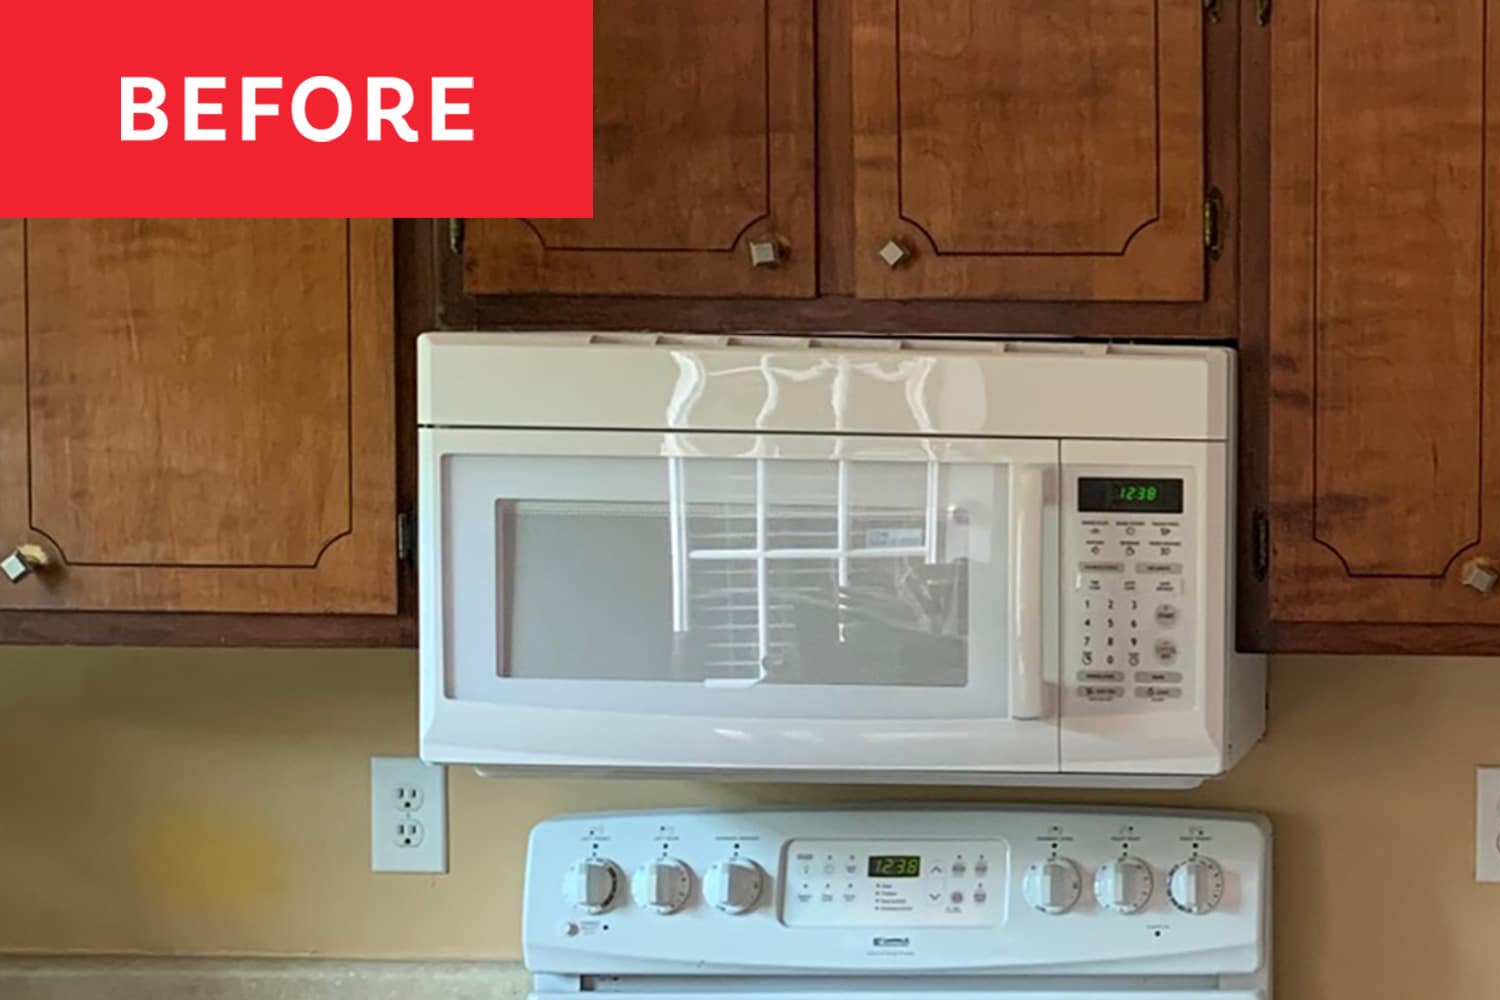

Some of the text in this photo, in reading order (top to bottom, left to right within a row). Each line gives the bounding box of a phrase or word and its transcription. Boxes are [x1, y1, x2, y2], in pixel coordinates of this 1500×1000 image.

[1107, 599, 1114, 610] 2
[1131, 599, 1138, 610] 3
[1084, 636, 1091, 646] 7
